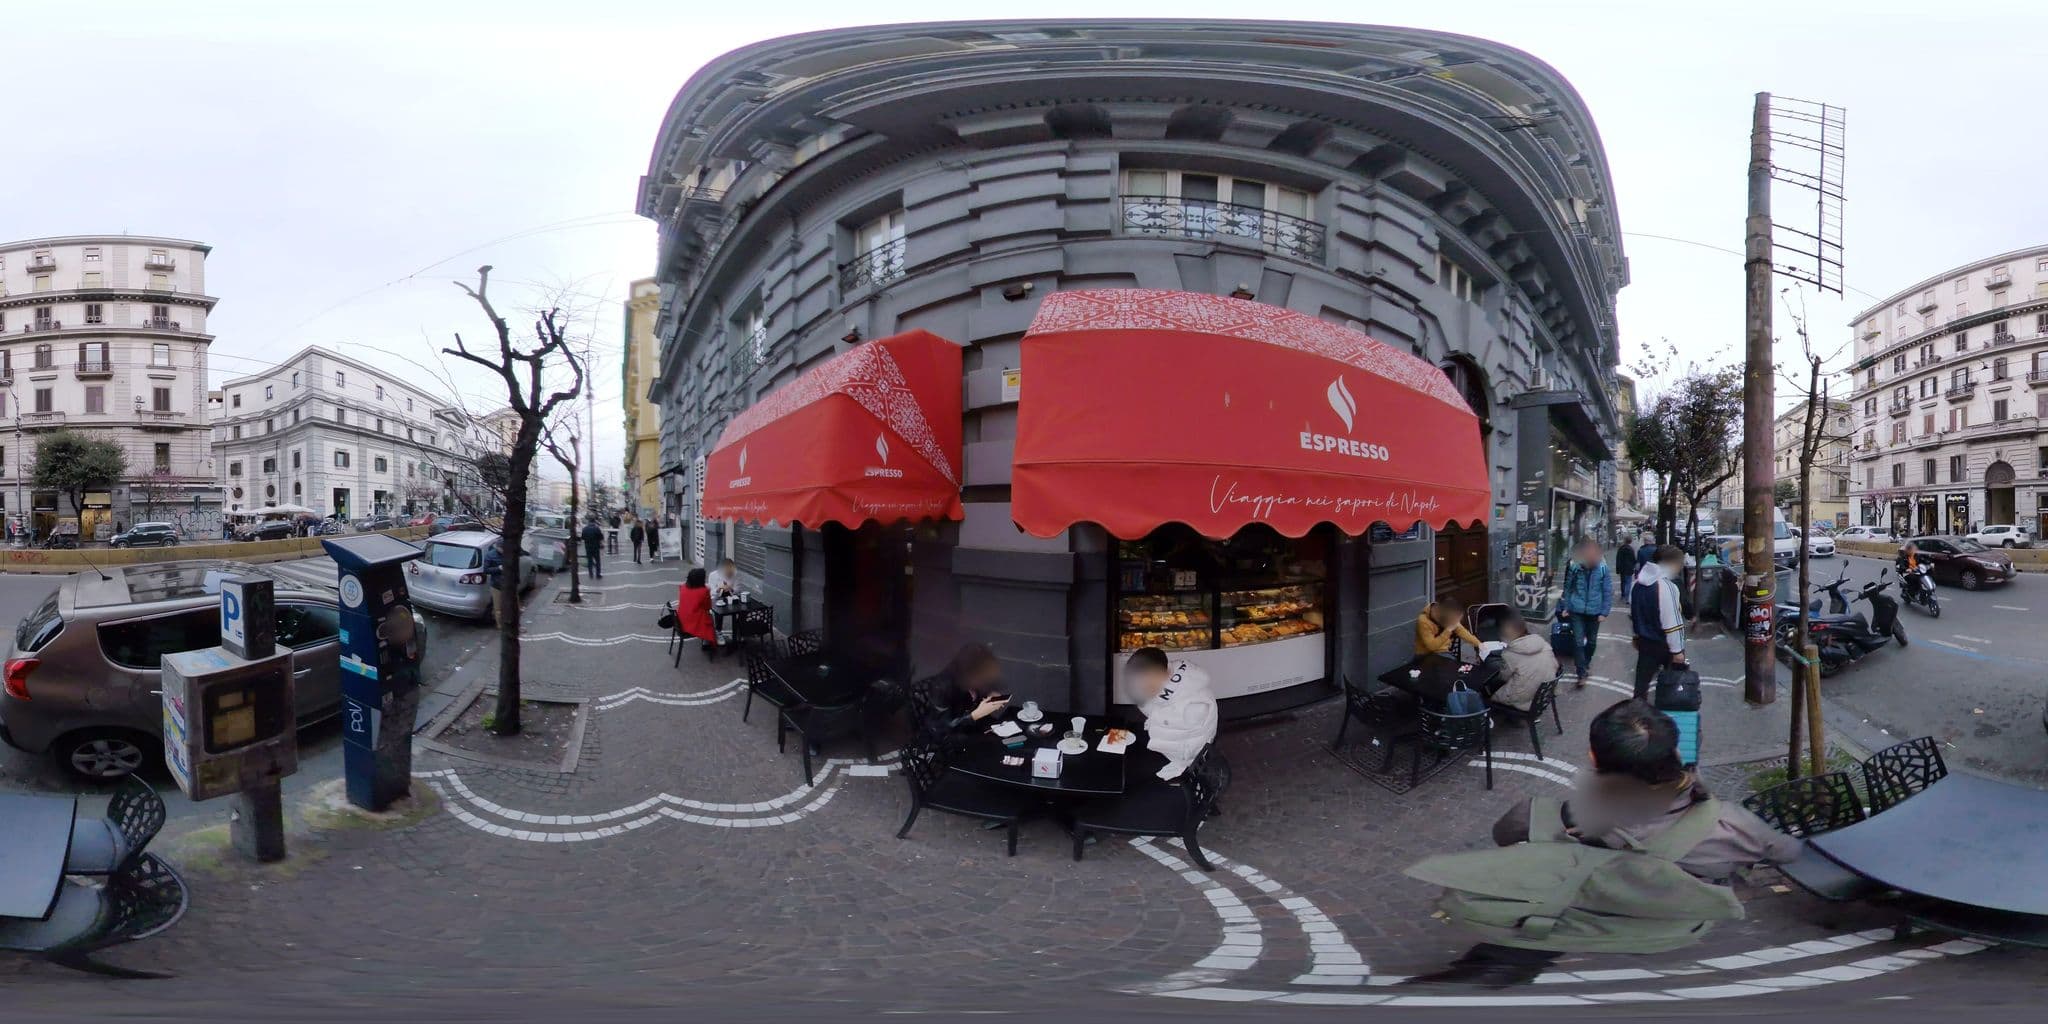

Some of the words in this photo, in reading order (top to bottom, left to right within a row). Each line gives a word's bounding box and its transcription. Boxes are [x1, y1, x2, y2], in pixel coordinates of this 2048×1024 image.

[1299, 431, 1390, 462] ESPRESSO
[1210, 474, 1302, 519] Viaggia
[1304, 496, 1333, 507] nei
[1335, 497, 1383, 517] sapori
[1385, 491, 1399, 511] di
[223, 589, 240, 631] P
